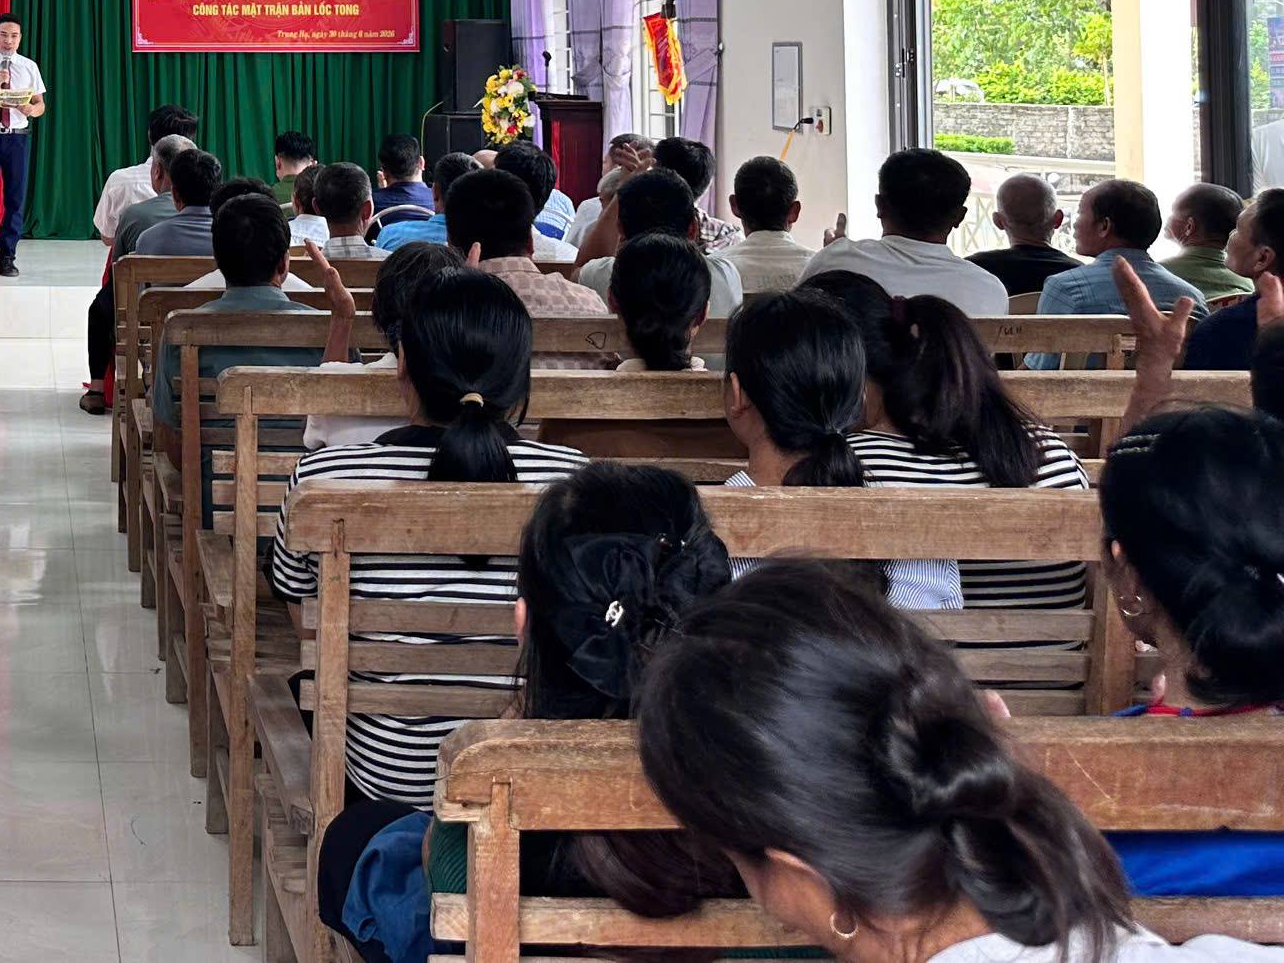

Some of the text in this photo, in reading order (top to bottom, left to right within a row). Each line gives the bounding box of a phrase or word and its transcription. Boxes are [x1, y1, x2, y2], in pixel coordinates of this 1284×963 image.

[193, 2, 219, 16] CÔNG
[221, 2, 239, 15] TÁC
[242, 2, 262, 17] MẶT
[264, 2, 289, 18] TRẬN
[291, 0, 311, 15] BẢN
[334, 4, 359, 15] TONG
